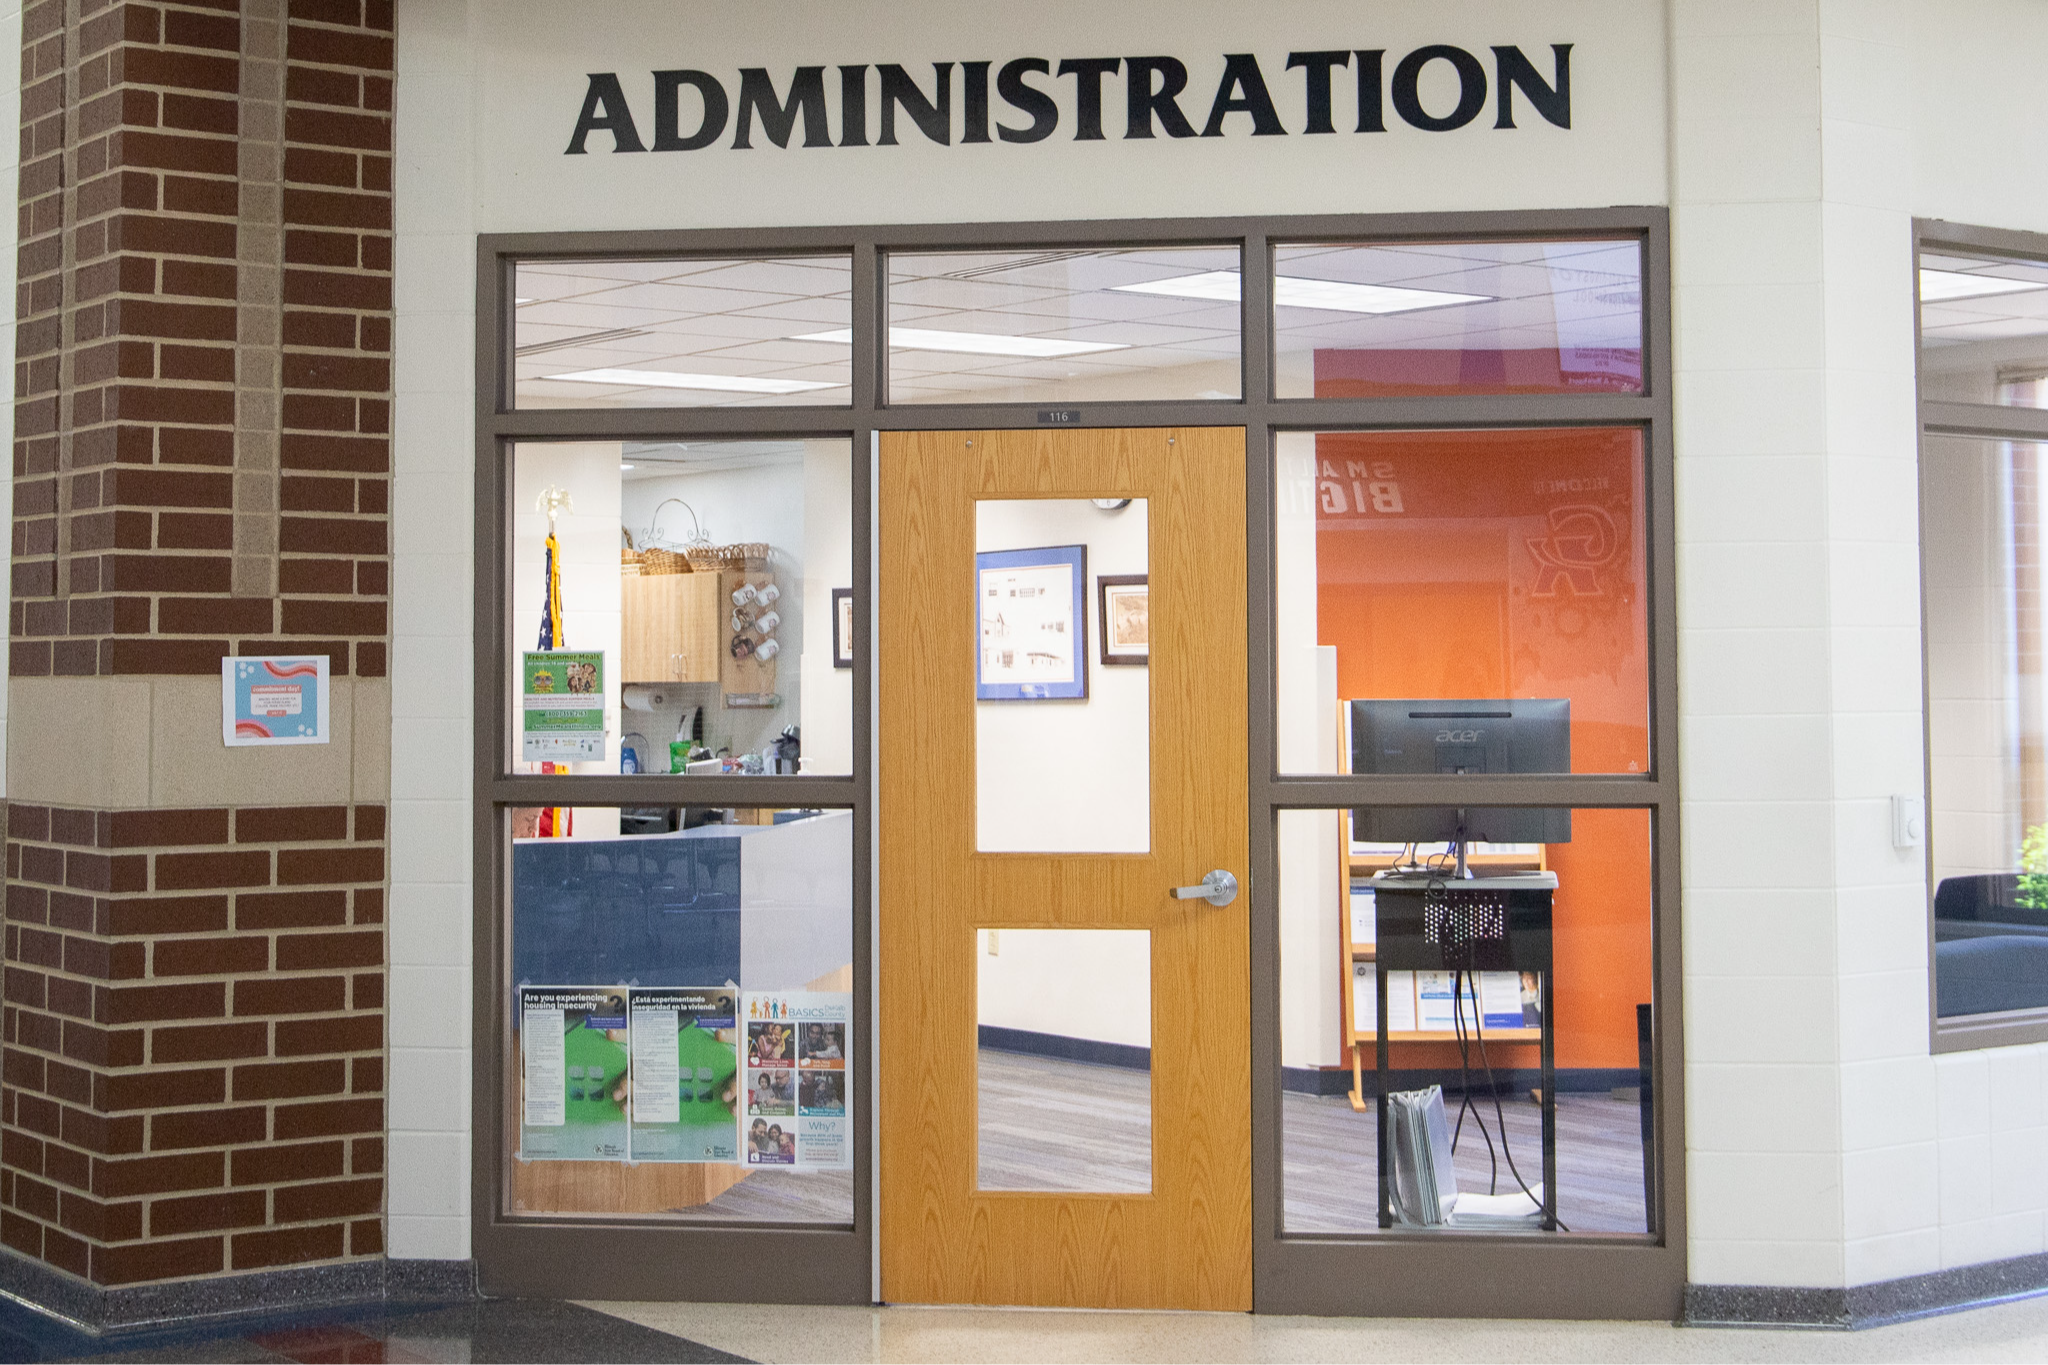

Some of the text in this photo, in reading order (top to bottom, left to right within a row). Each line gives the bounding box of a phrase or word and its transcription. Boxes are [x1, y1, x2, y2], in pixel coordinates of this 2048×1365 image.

[565, 43, 1574, 155] ADMINISTRATION
[1050, 412, 1068, 422] 116
[1436, 730, 1486, 742] acer
[556, 994, 608, 1003] experiencing
[632, 996, 650, 1004] ¿Está
[524, 1002, 597, 1011] housing insecurity
[789, 1008, 824, 1017] BASICS
[809, 1121, 835, 1131] Why?
